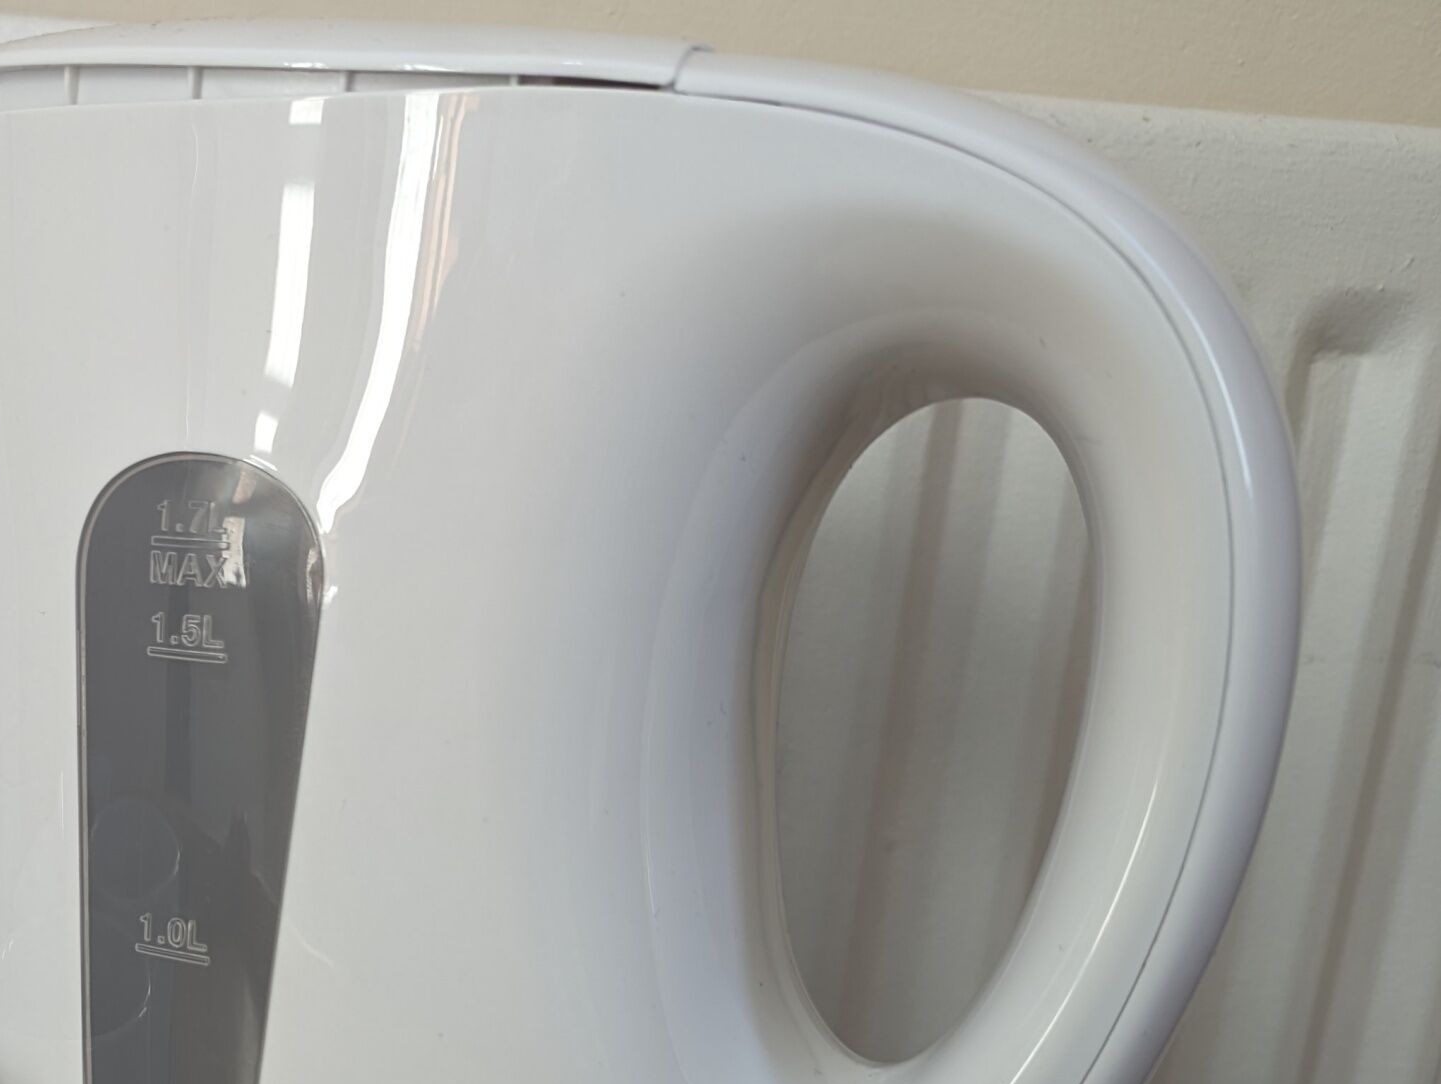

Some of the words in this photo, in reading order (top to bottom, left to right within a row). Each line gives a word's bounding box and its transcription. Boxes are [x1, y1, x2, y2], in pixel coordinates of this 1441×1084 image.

[149, 550, 229, 589] MAX
[150, 611, 225, 649] 1.5L
[139, 912, 208, 952] 1.0L
